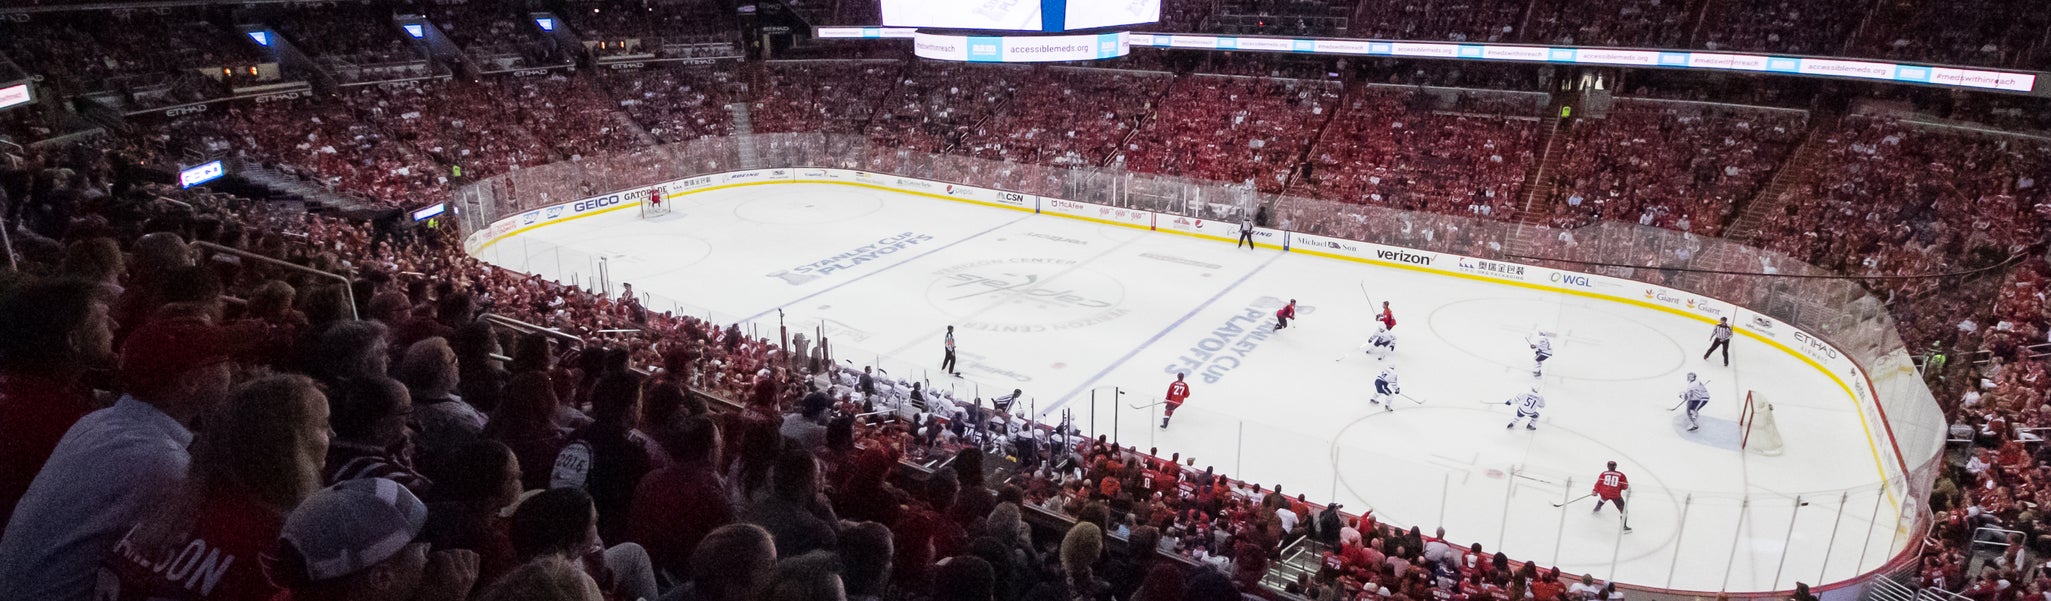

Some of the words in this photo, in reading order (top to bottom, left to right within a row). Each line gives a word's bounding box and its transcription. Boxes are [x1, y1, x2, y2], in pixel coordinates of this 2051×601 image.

[1010, 44, 1089, 54] accessiblemeds.org
[1808, 62, 1887, 75] accessiblemeds.org
[1936, 73, 2016, 86] #medswithinrach
[166, 104, 207, 117] ETIHAD
[624, 185, 667, 201] GATORDE
[1006, 192, 1024, 202] CSN
[574, 195, 619, 212] GEICO
[1058, 200, 1084, 209] McAfee
[1298, 237, 1327, 248] Michael
[1343, 244, 1357, 252] Son
[794, 243, 877, 274] STANLEY
[878, 231, 913, 246] CUP
[817, 233, 935, 276] PLAYOFFS
[1377, 249, 1430, 266] verizon
[1008, 257, 1078, 265] CENTER
[1563, 274, 1592, 287] WGL
[1656, 292, 1680, 304] Giant
[1698, 302, 1721, 315] Giant
[962, 320, 1047, 334] CENTER
[1164, 307, 1266, 378] PLAYOFFS
[1794, 331, 1837, 360] ETIHAD
[1200, 355, 1241, 385] CUP
[1173, 385, 1185, 396] 27
[1523, 396, 1537, 409] 51
